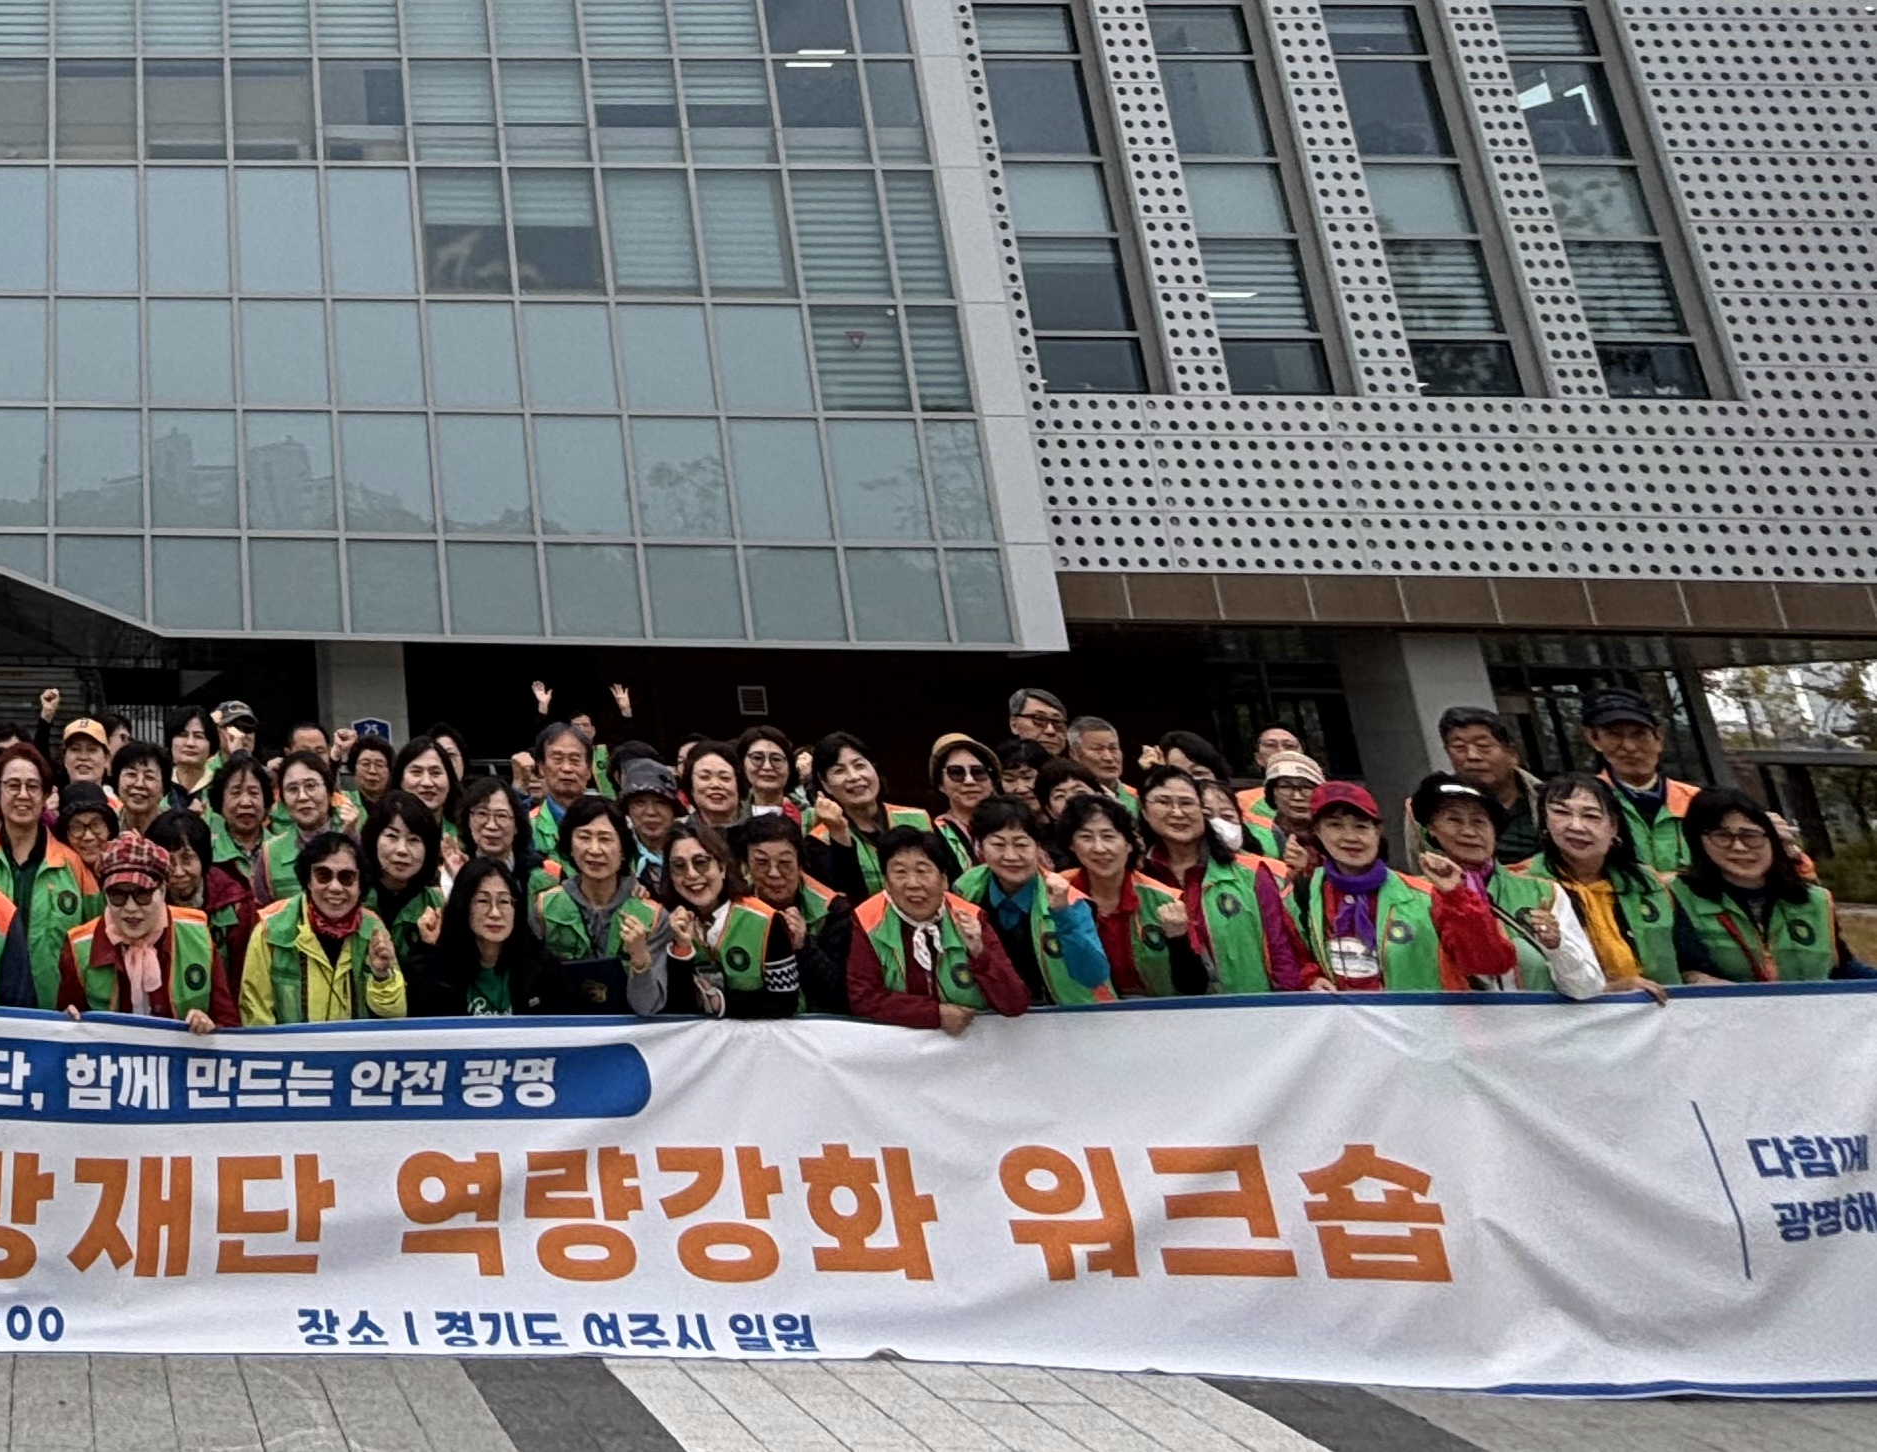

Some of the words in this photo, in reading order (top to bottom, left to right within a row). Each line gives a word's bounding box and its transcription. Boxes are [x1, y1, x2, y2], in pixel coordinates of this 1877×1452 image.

[66, 1054, 170, 1111] 함께
[186, 1057, 335, 1108] 만드는
[350, 1060, 448, 1106] 안전
[461, 1056, 558, 1107] 광명
[1746, 1134, 1869, 1178] 다함께
[396, 1143, 937, 1282] 역량강화
[998, 1143, 1453, 1283] 워크숍
[1771, 1192, 1877, 1242] 광명해
[298, 1309, 389, 1346] 장소
[435, 1311, 569, 1348] 경기도
[583, 1312, 715, 1351] 여주시
[729, 1313, 820, 1352] 일원
